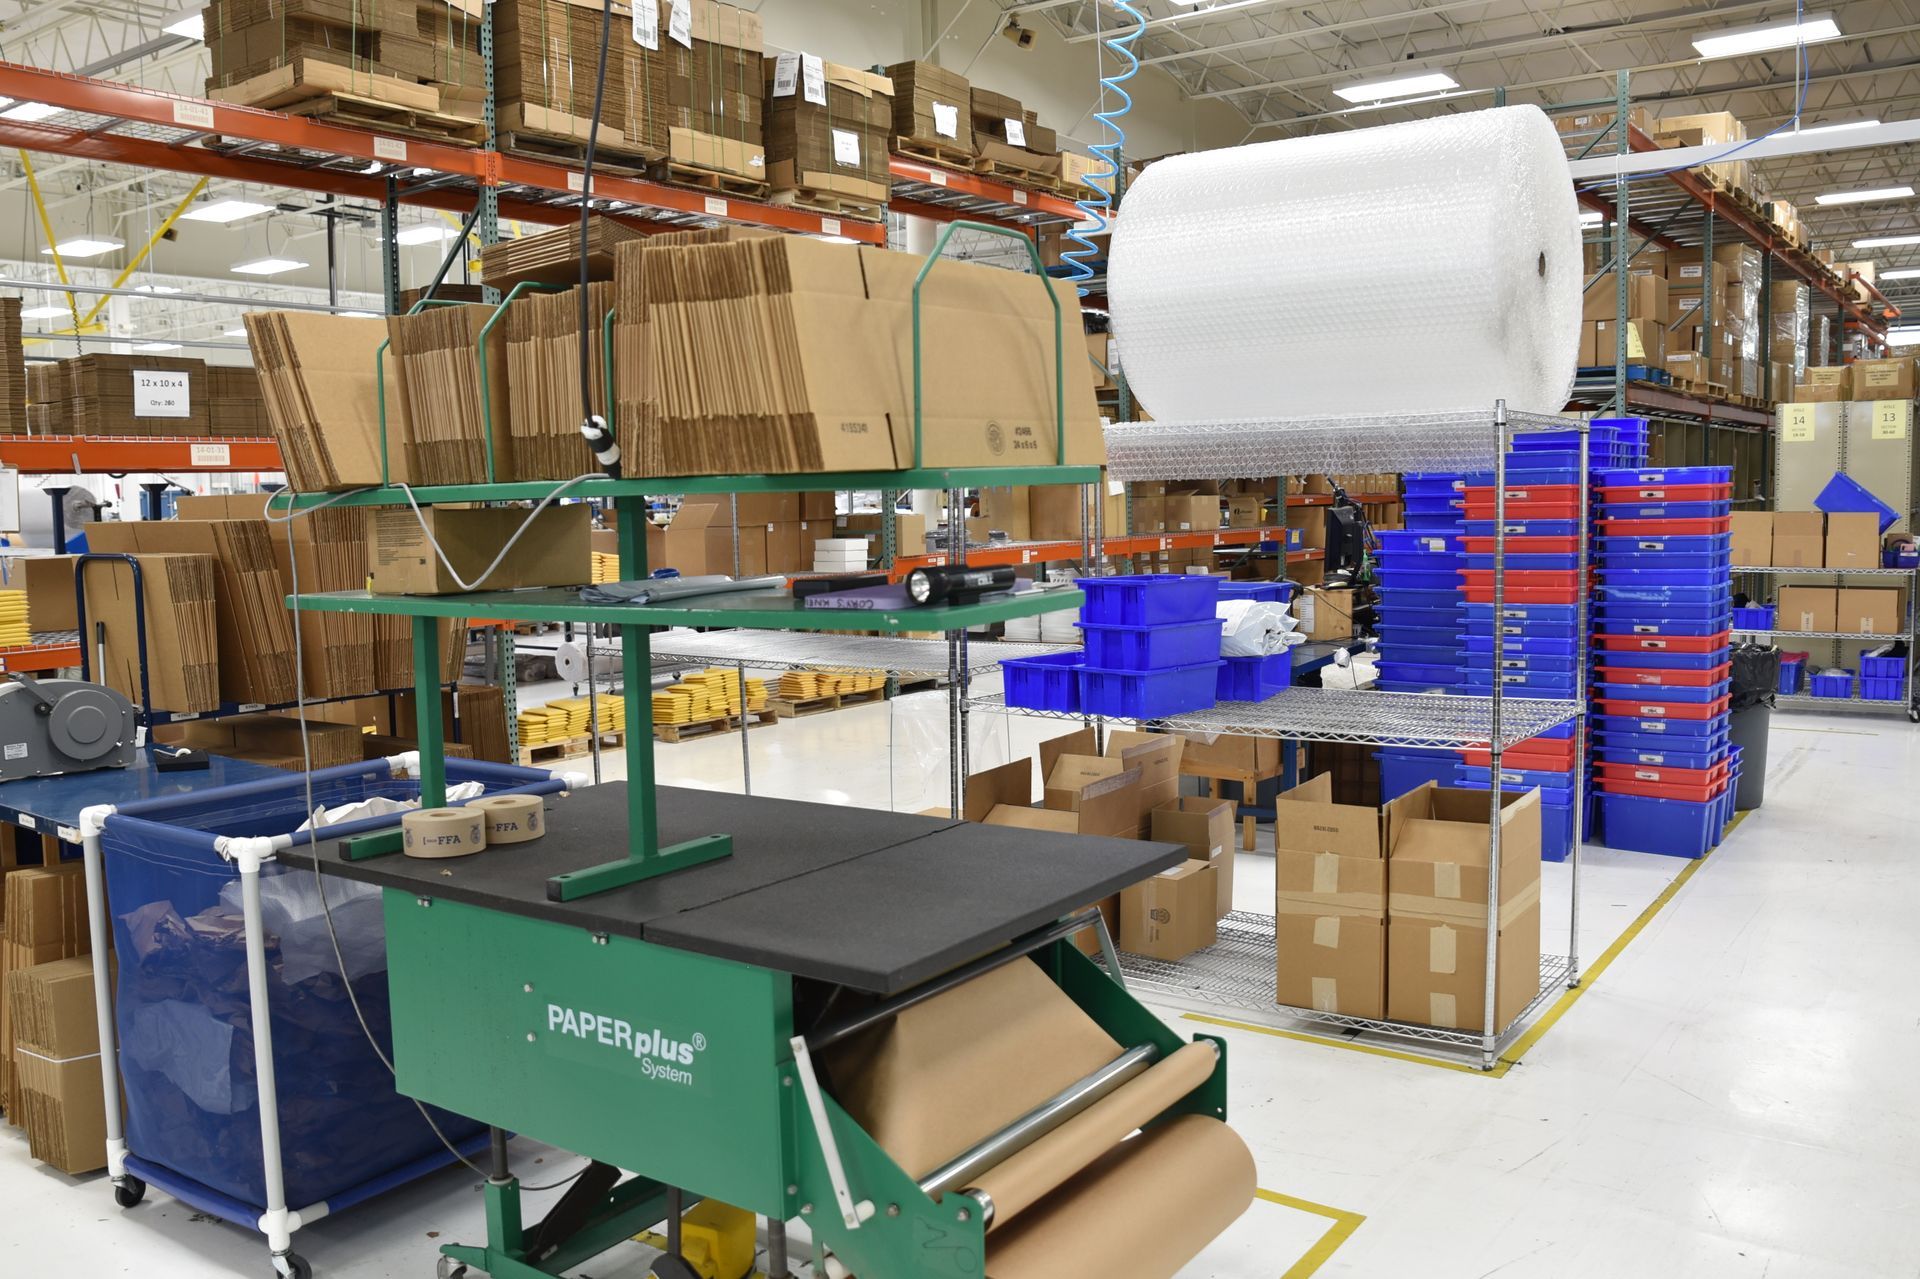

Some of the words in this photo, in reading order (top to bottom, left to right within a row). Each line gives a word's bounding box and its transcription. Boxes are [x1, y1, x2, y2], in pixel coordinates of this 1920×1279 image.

[141, 379, 151, 387] 12
[160, 380, 170, 388] 10
[177, 380, 183, 388] 4
[1793, 416, 1805, 425] 14
[1882, 412, 1896, 422] 13
[495, 822, 519, 832] FFA
[437, 834, 462, 845] FFA
[641, 1057, 692, 1086] System
